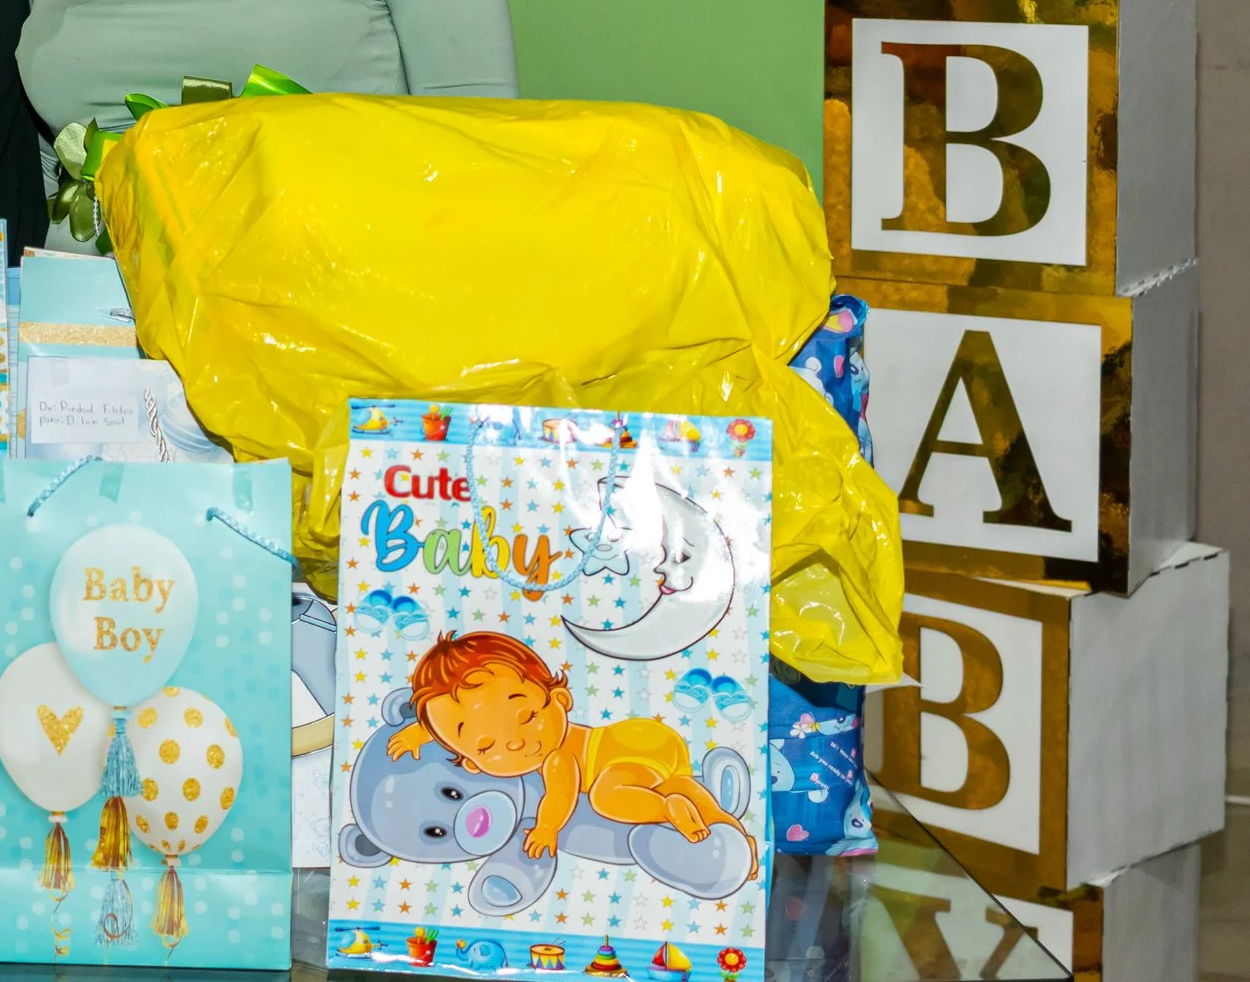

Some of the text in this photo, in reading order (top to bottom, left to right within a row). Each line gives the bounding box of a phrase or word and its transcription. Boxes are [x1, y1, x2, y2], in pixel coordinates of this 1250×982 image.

[384, 464, 472, 502] Cute
[360, 499, 563, 602] Baby
[82, 565, 175, 614] Baby
[93, 616, 164, 664] Boy
